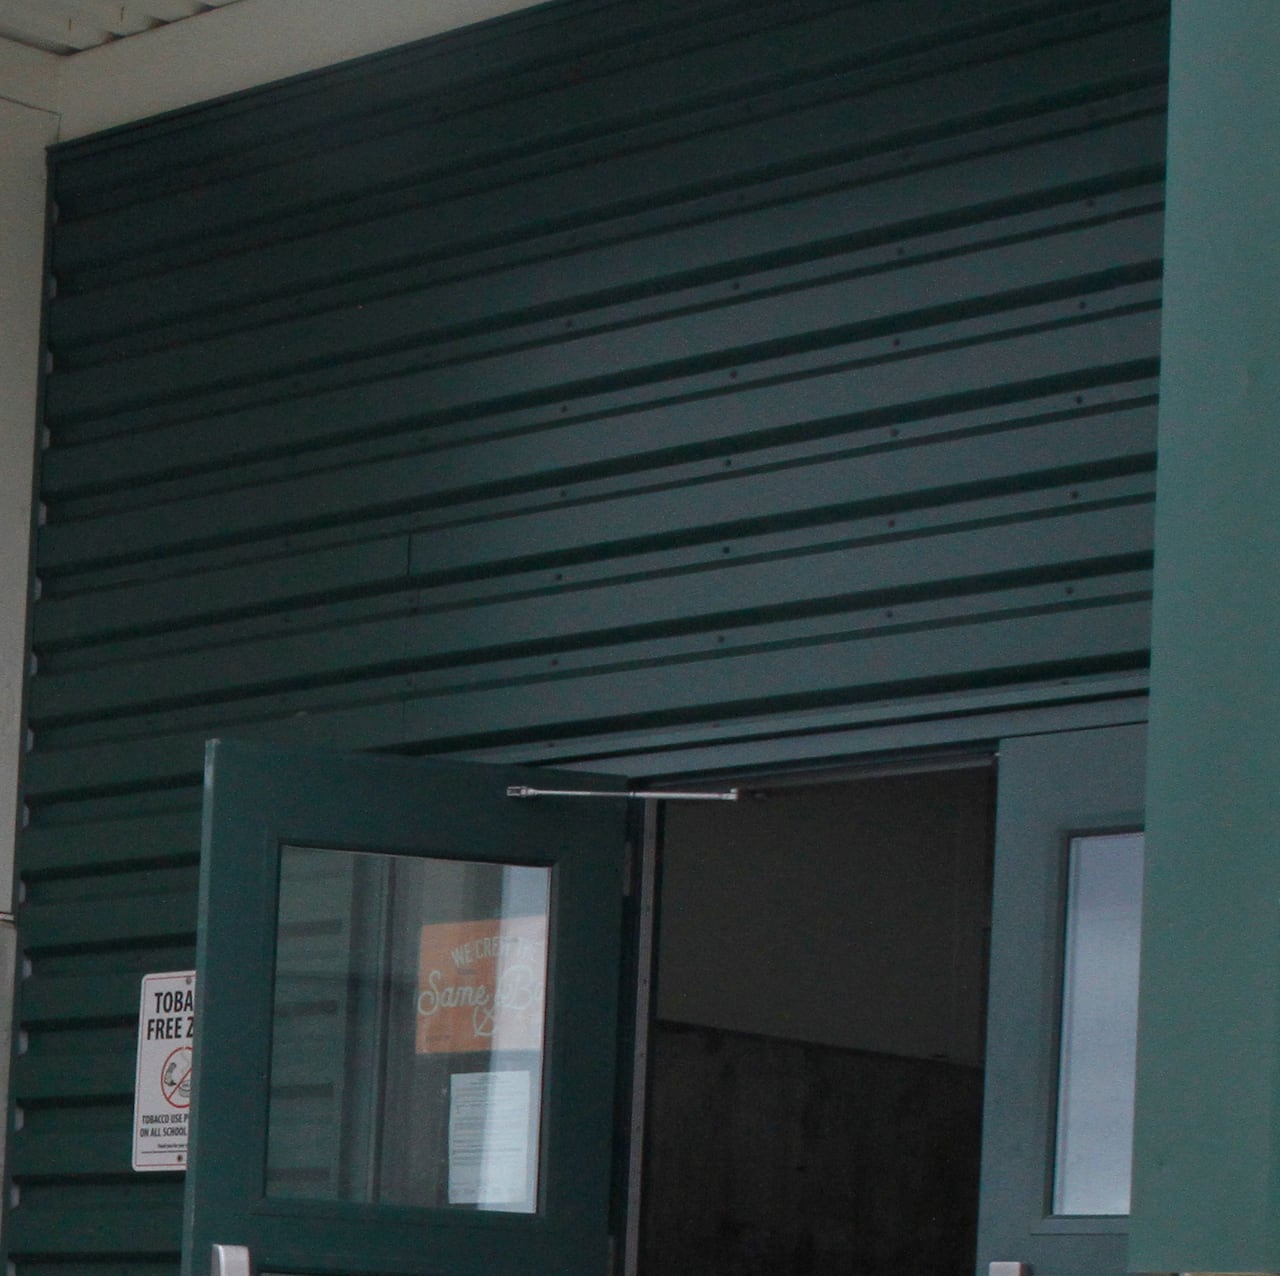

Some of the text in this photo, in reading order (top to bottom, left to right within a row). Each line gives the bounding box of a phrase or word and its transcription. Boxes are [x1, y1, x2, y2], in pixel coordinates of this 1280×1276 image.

[154, 990, 193, 1014] TOBA
[417, 969, 490, 1016] Same
[147, 1017, 182, 1040] FREE
[150, 1128, 161, 1136] ALL
